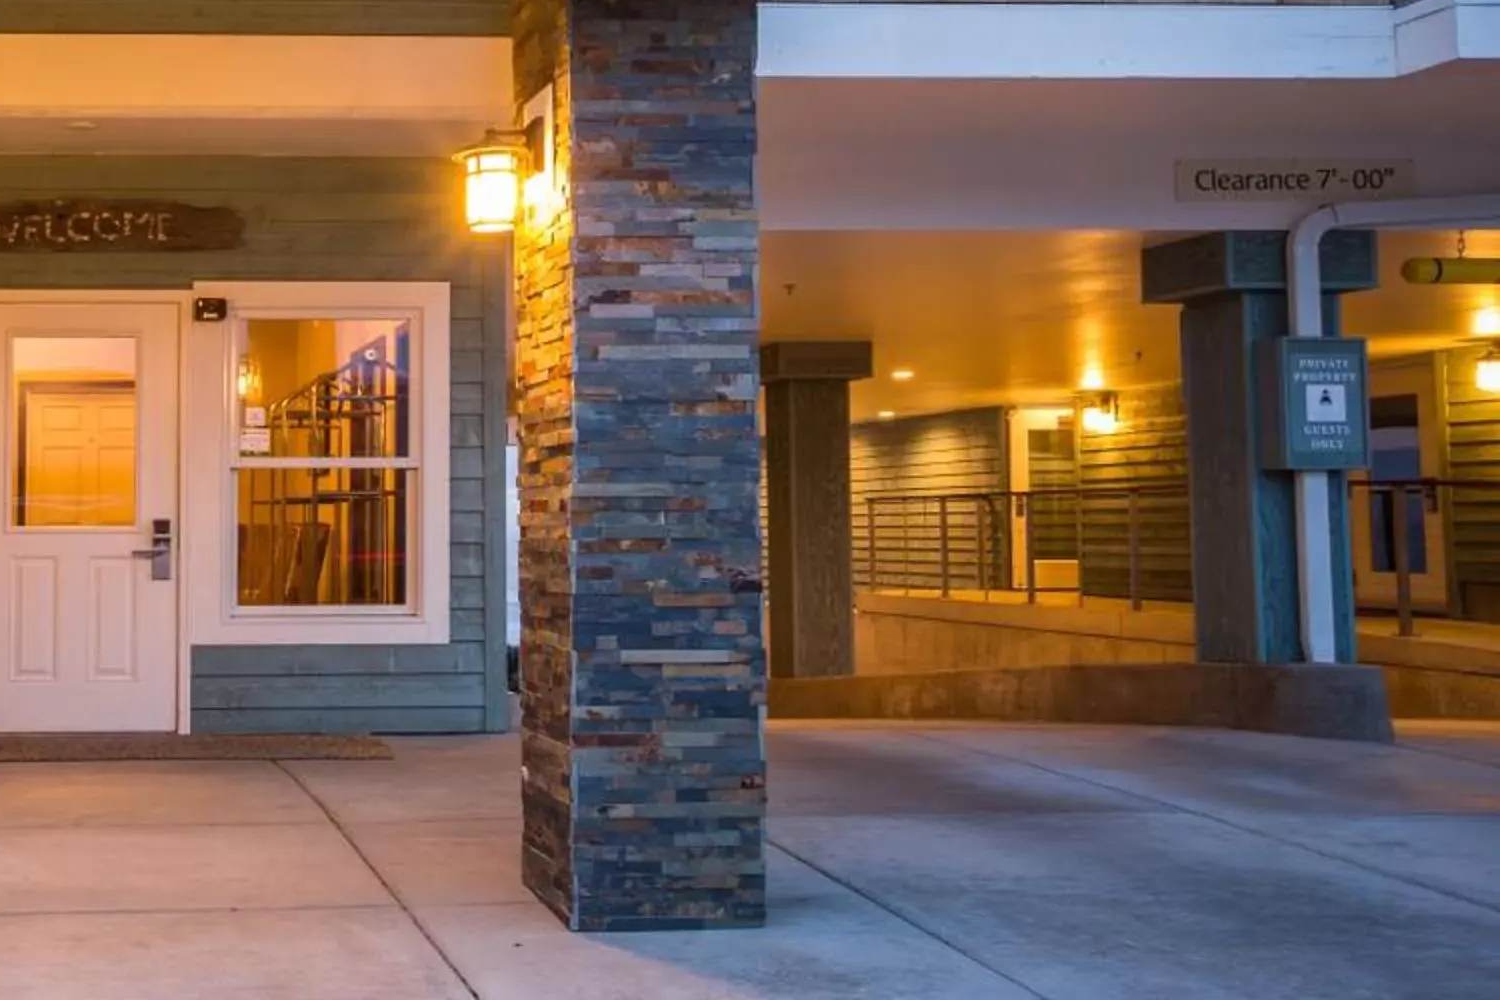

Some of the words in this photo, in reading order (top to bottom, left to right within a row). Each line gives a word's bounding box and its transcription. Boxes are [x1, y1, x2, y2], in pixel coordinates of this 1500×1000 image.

[1195, 169, 1310, 192] Clearance
[1299, 359, 1349, 369] PRIVATE
[1293, 371, 1356, 382] PROPERTY
